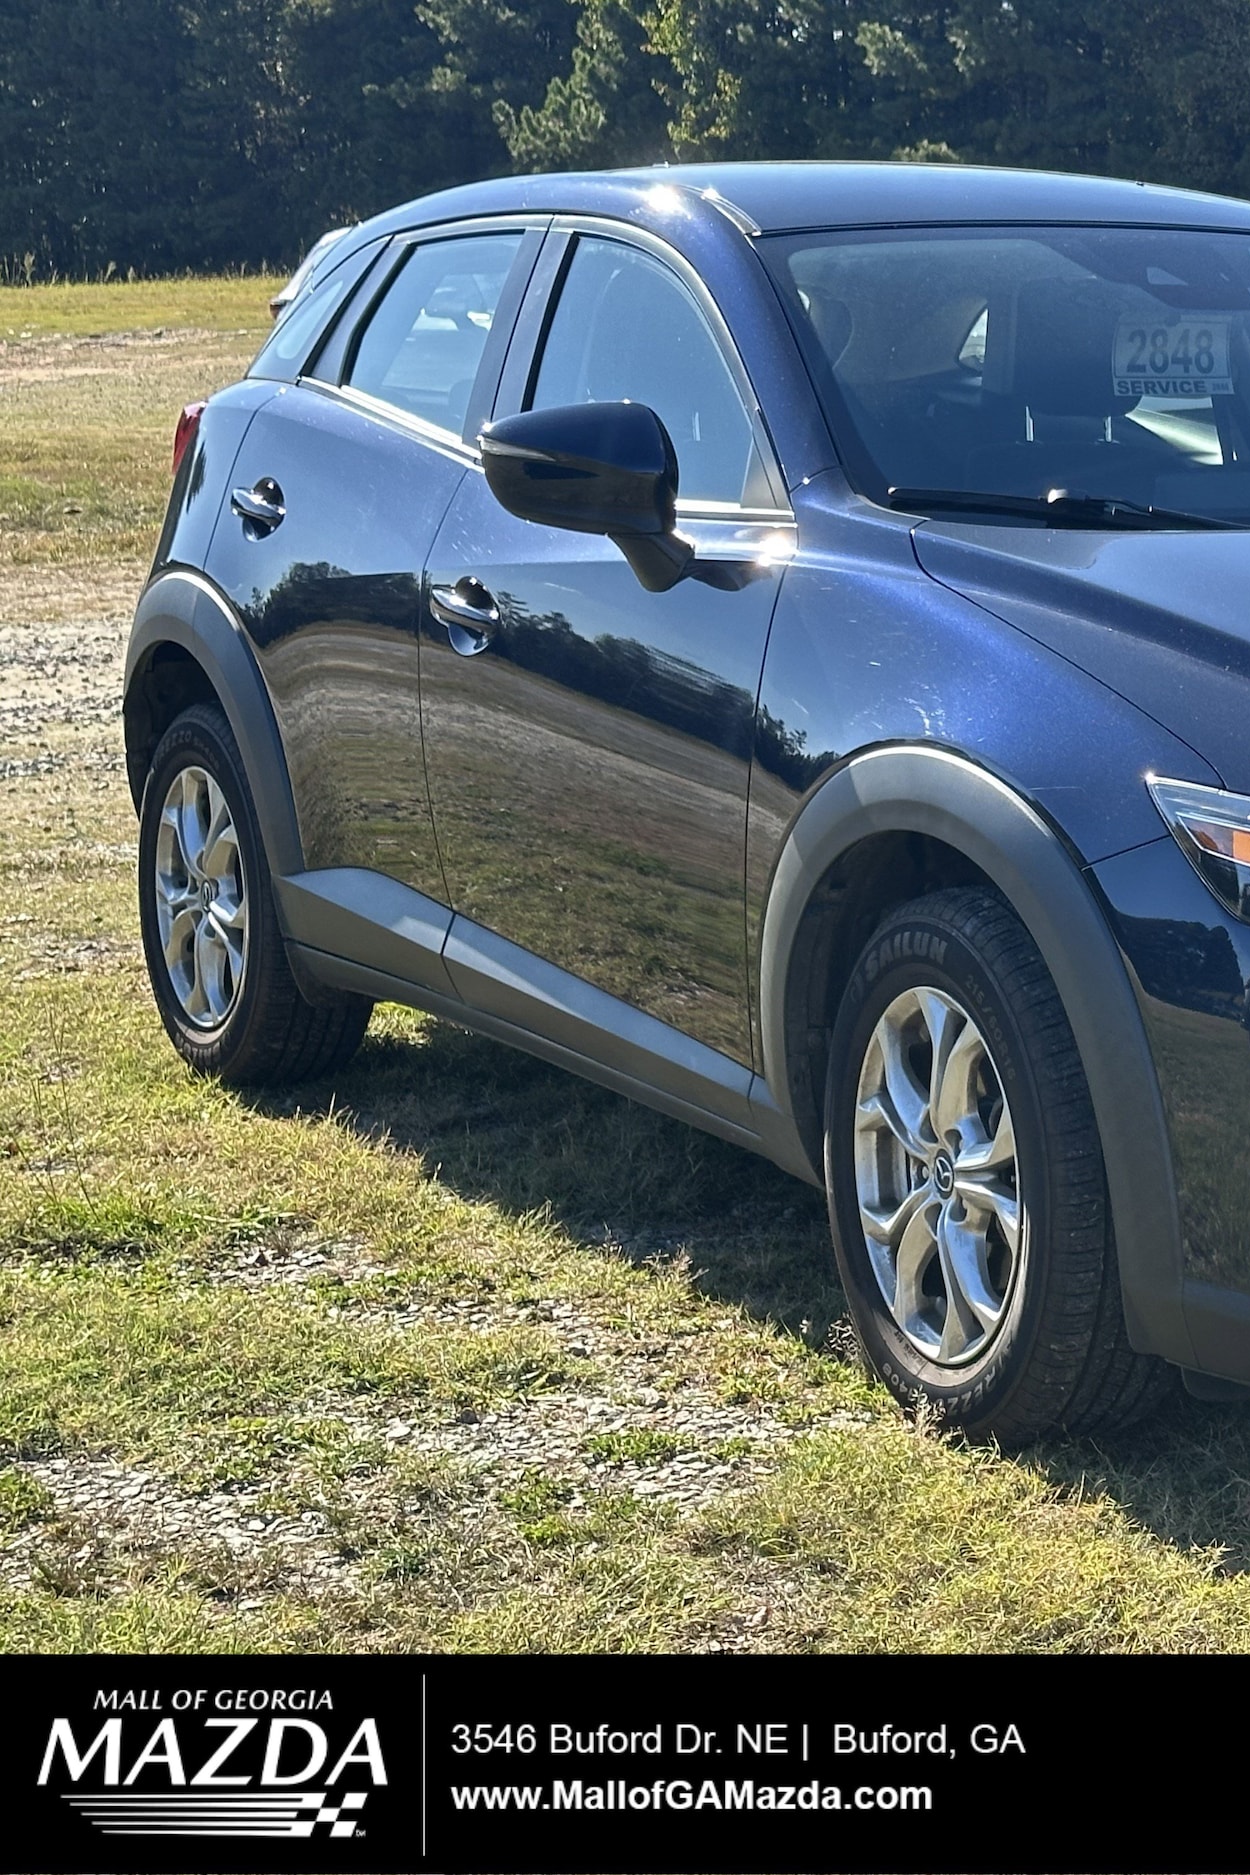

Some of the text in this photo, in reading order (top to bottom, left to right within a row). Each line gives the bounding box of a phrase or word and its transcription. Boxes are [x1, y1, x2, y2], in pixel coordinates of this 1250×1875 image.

[1126, 328, 1215, 375] 2848
[1117, 380, 1208, 395] SERVICE
[865, 931, 948, 982] SAILUN
